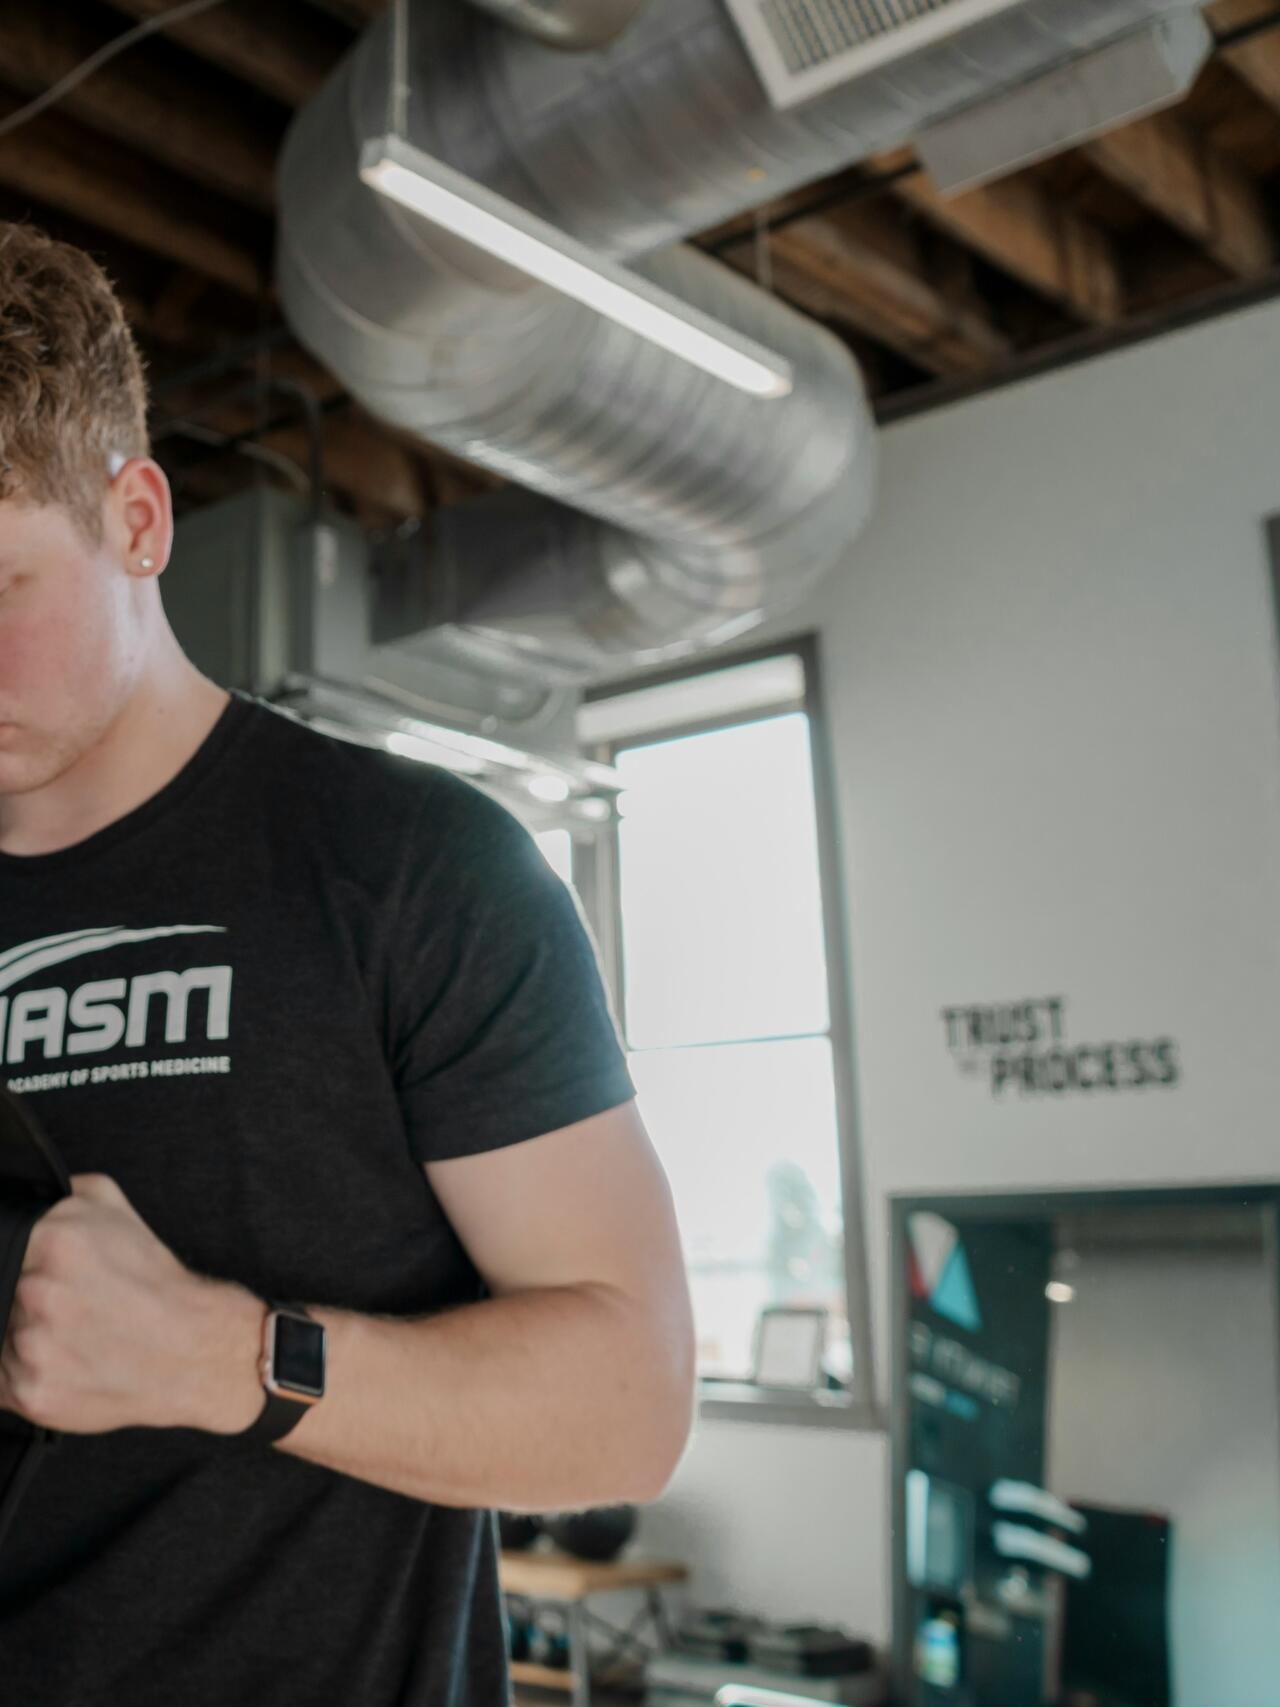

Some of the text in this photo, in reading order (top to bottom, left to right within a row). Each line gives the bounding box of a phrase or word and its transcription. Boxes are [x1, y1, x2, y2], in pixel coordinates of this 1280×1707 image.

[941, 997, 1063, 1047] TRUST
[70, 1069, 90, 1086] OF
[90, 1061, 149, 1084] SPORTS
[152, 1056, 231, 1076] MEDICINE
[991, 1038, 1179, 1097] PROCESS
